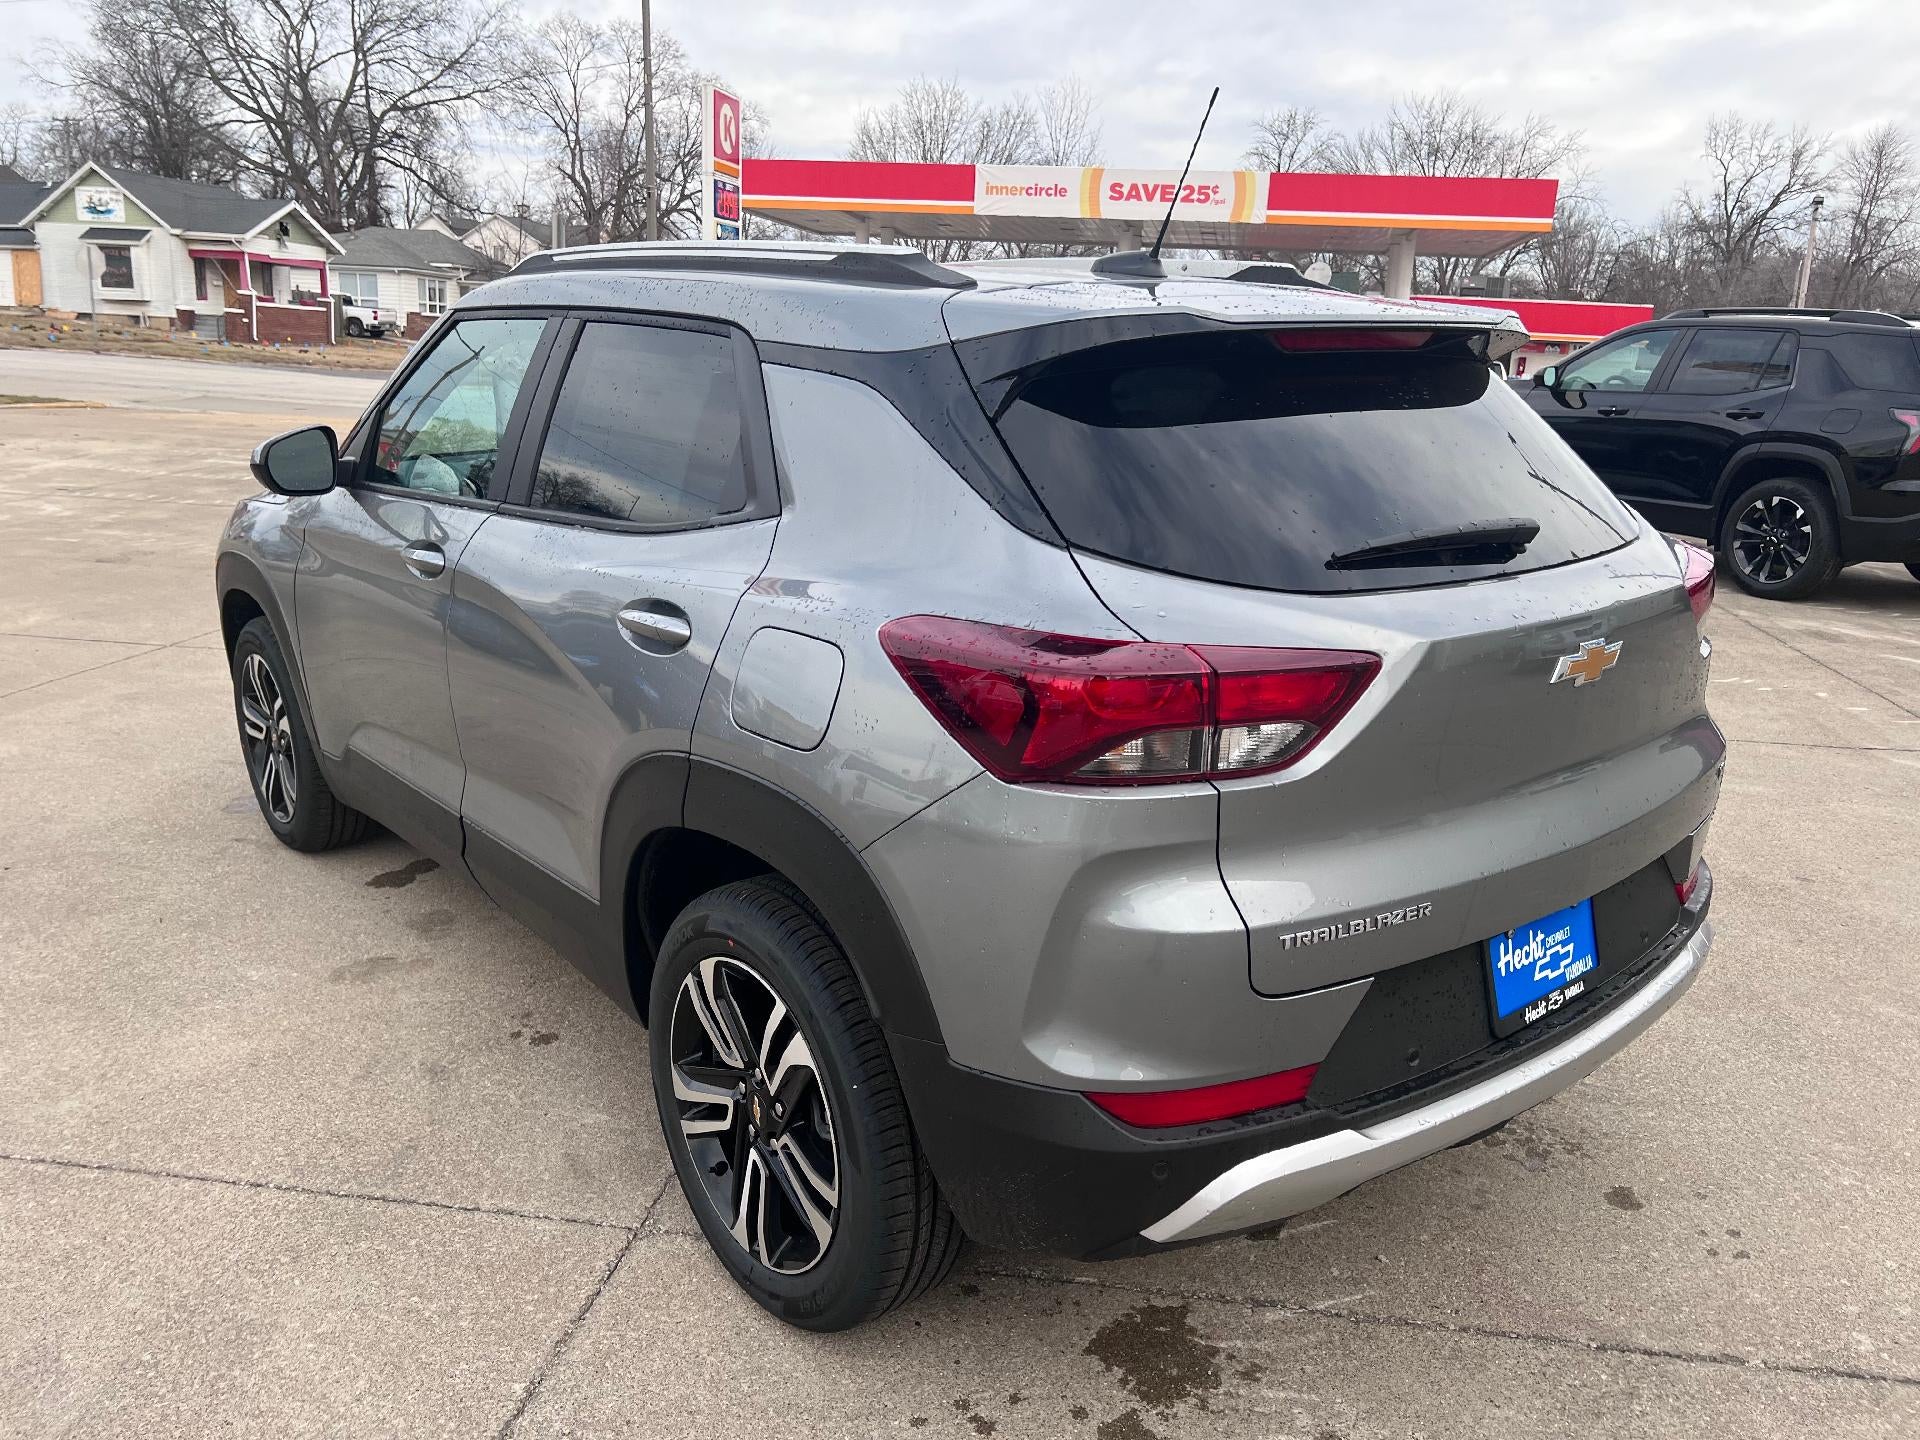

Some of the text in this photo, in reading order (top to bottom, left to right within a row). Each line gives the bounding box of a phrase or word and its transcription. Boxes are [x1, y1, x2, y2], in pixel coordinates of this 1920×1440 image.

[723, 112, 735, 152] K
[984, 181, 1068, 198] innercircle
[1108, 182, 1176, 203] SAVE
[1278, 902, 1433, 951] TRAILBLAZER
[1497, 929, 1545, 977] Hecht
[1564, 953, 1593, 982] VANDALIA
[1524, 1000, 1547, 1025] Hecht
